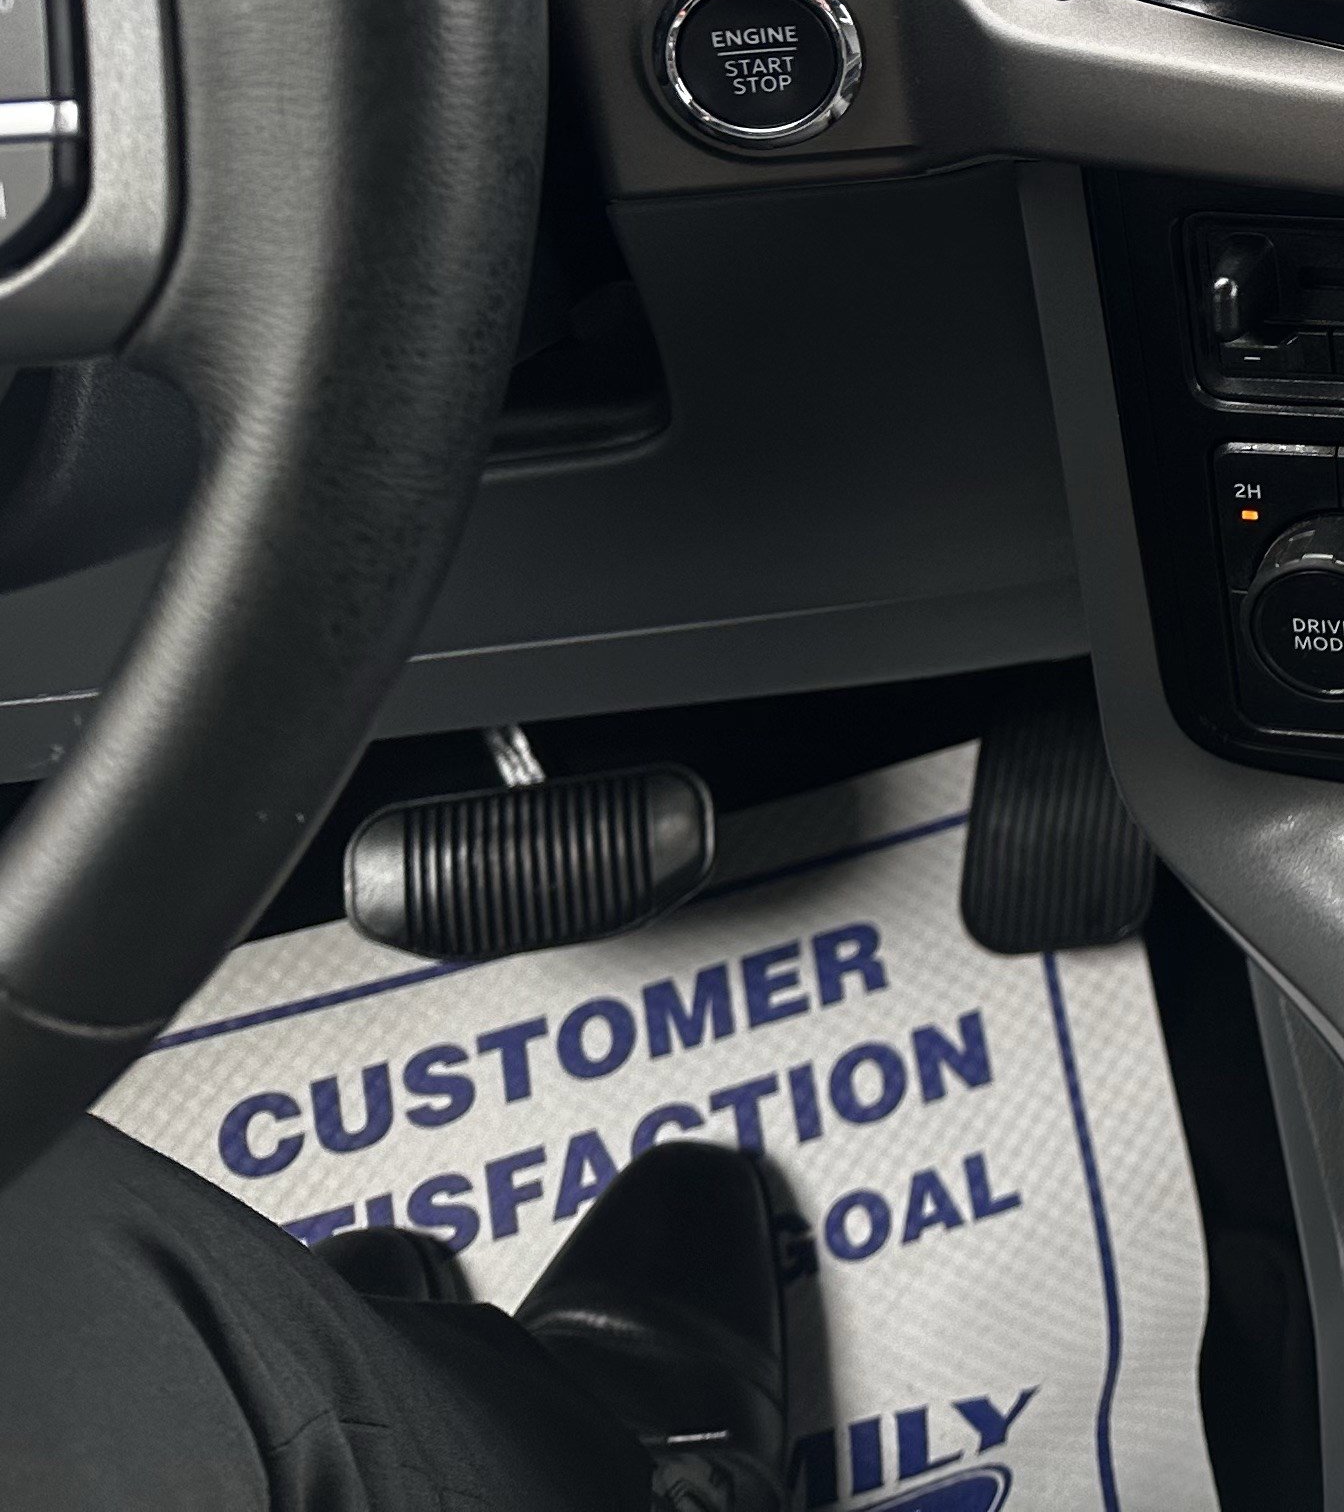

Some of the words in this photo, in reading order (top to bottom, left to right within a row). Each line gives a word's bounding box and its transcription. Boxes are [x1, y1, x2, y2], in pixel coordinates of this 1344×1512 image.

[711, 25, 799, 48] ENGINE
[724, 56, 795, 77] START
[732, 75, 792, 95] STOP
[1234, 483, 1262, 500] 2H
[217, 922, 891, 1179] CUSTOMER
